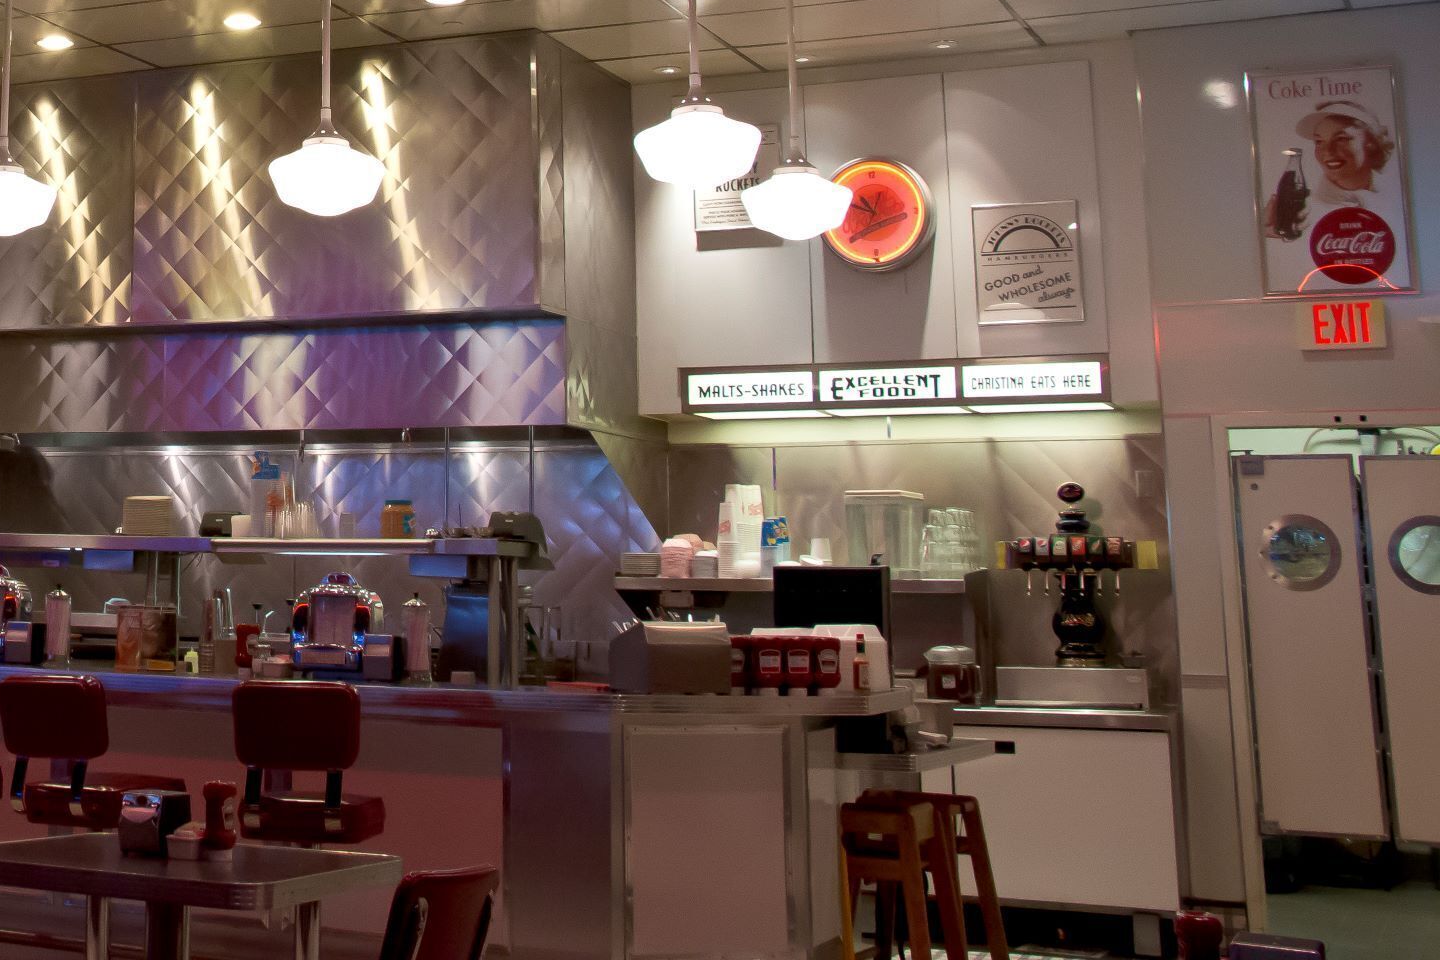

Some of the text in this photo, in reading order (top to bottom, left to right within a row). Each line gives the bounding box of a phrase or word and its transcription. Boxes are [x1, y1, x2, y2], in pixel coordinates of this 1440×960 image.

[1268, 76, 1362, 100] Coke Time
[984, 264, 1044, 292] GOOD and
[998, 272, 1073, 302] WHOLESOME
[1312, 302, 1371, 345] EXIT
[697, 383, 805, 399] MALTS-SHAKES
[831, 373, 941, 400] EXCELLENT
[859, 386, 917, 398] FOOD
[971, 373, 1091, 390] CHRISTINA EATS HERE
